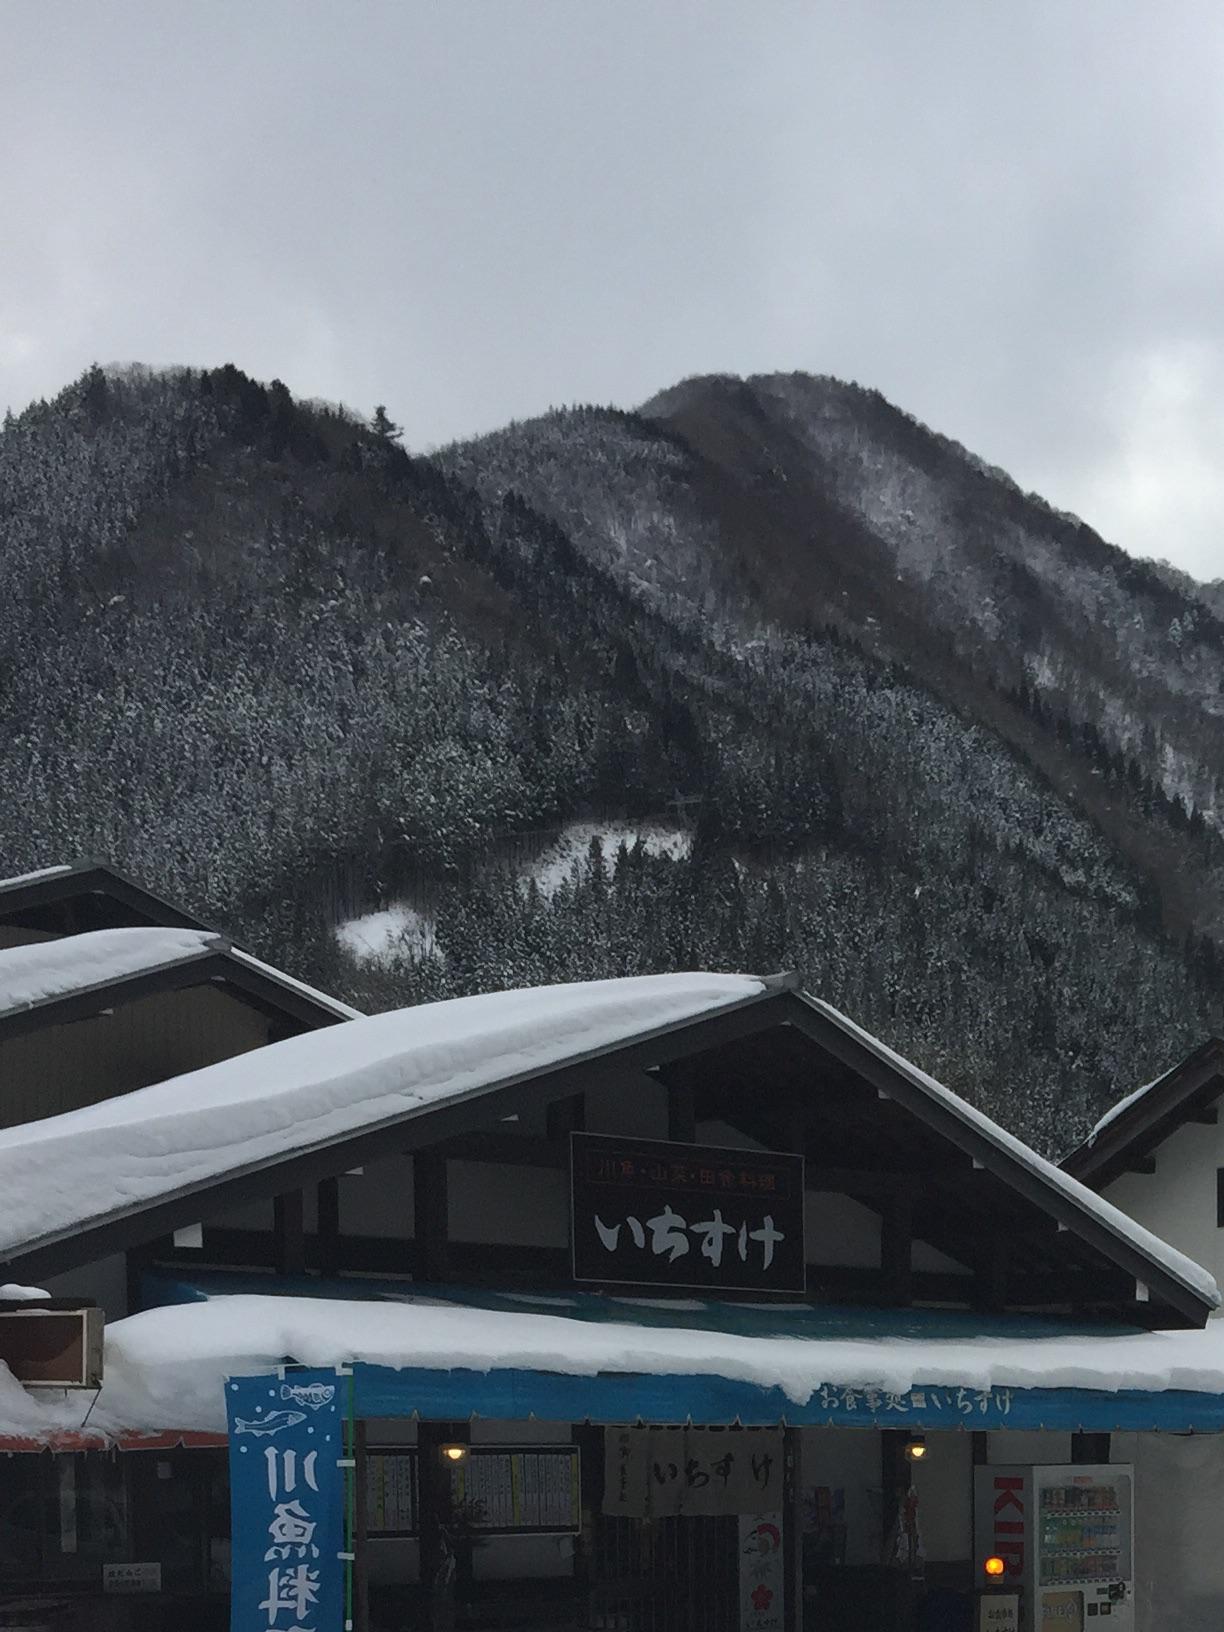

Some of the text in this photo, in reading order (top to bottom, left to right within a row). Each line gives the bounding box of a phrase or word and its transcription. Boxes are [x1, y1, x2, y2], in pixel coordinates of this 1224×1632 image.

[593, 1204, 786, 1271] いちすけ
[820, 1383, 1013, 1415] お食事処 いちすけ
[653, 1453, 773, 1489] いちすけ
